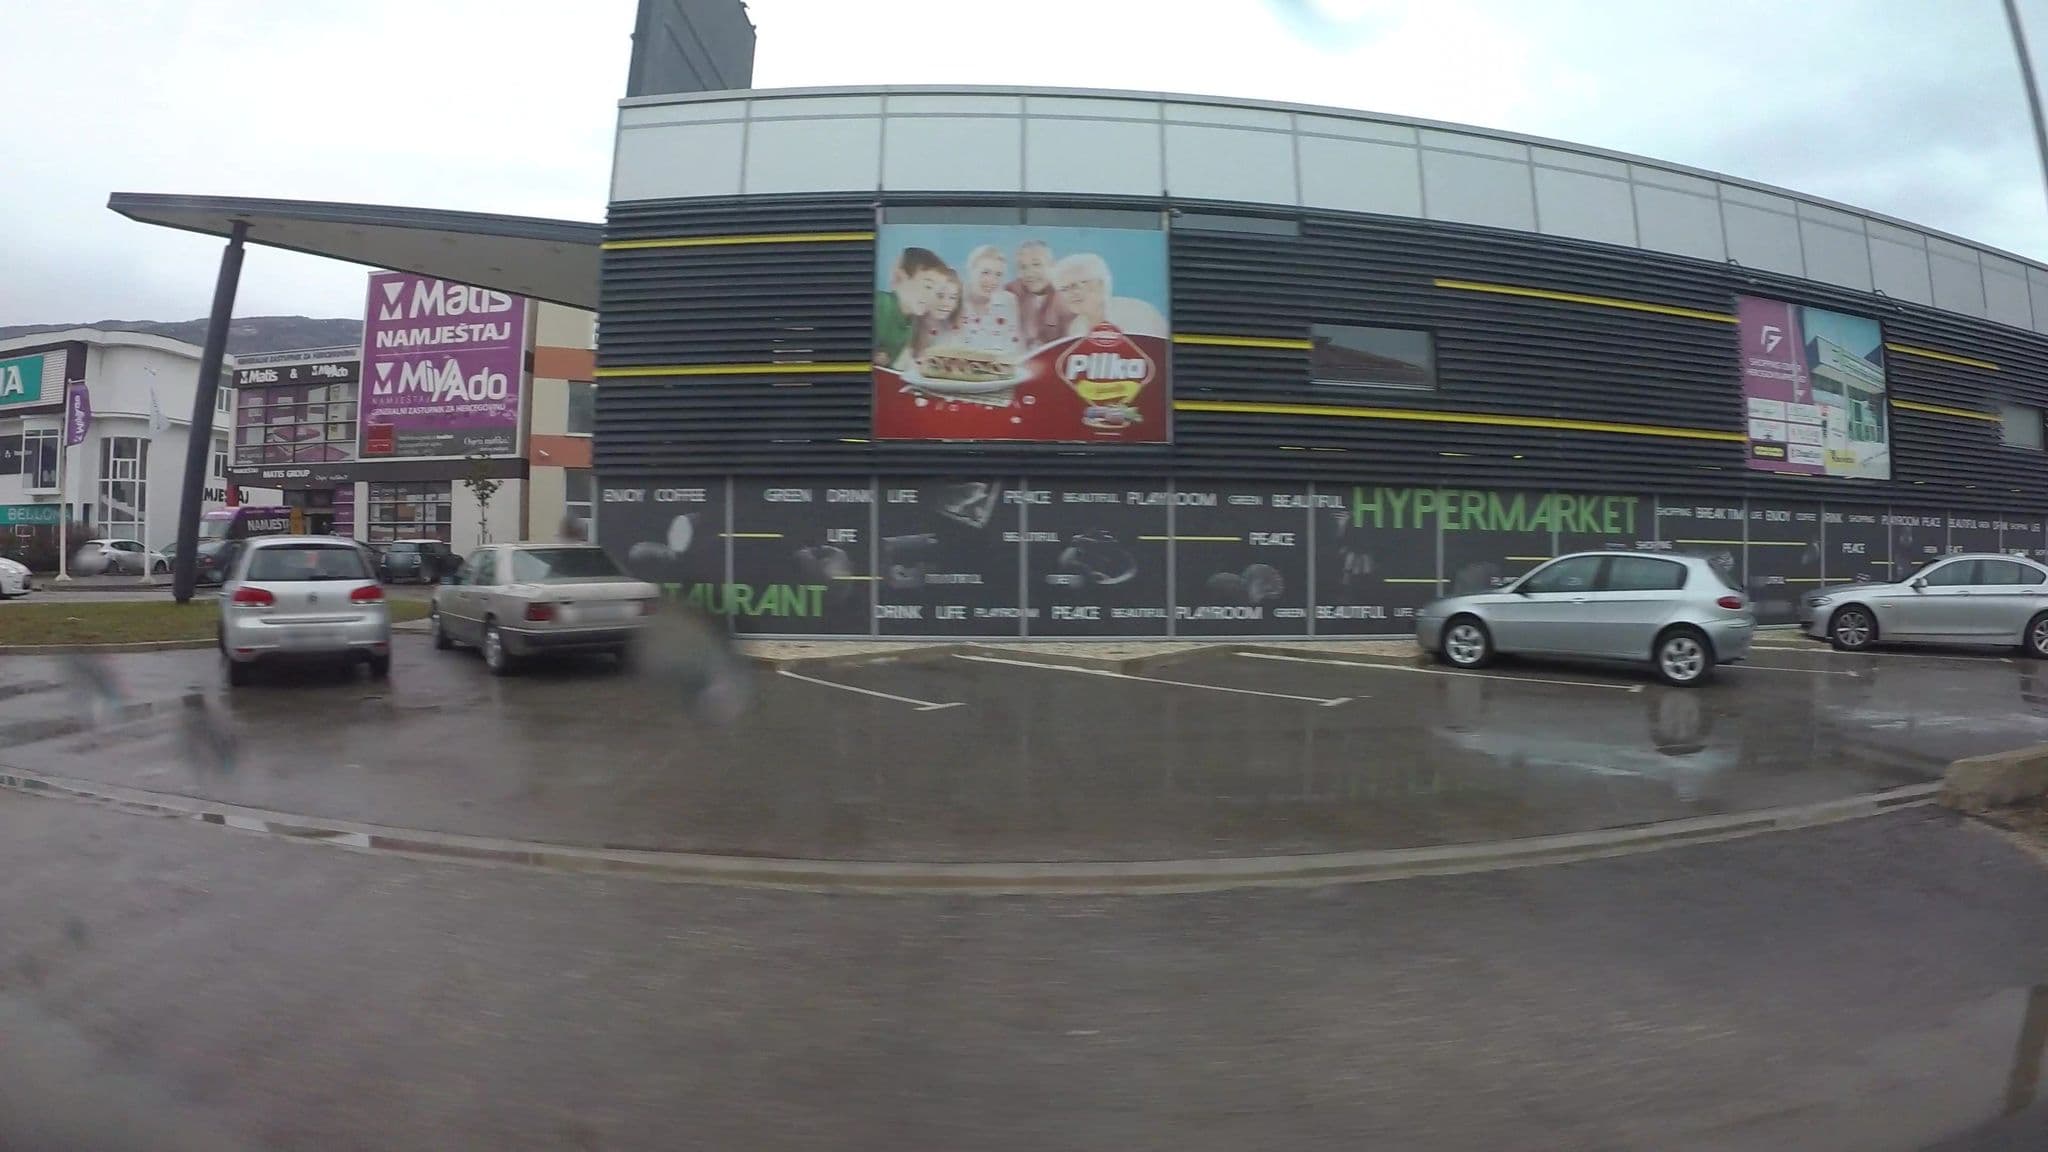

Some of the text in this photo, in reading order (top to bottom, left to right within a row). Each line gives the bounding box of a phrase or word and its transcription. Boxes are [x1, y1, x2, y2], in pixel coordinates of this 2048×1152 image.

[408, 277, 513, 319] Matis
[376, 321, 511, 349] NAMJEŠTAJ
[289, 368, 298, 379] &
[602, 488, 707, 503] ENJOY COFFEE
[763, 488, 920, 504] GREEN DRINK LIFE
[1003, 490, 1053, 505] PEACE
[1272, 494, 1346, 509] BEAUTIFUL
[1352, 486, 1639, 535] HYPERMARKET
[1695, 506, 1728, 520] BREAK
[826, 528, 858, 543] LIFE
[1248, 532, 1296, 547] PEACE
[876, 605, 923, 620] DRINK
[935, 605, 968, 620] LIFE
[1051, 605, 1102, 620] PEACE
[1175, 606, 1264, 620] PLAYROOM
[1316, 605, 1388, 620] BEAUTIFUL
